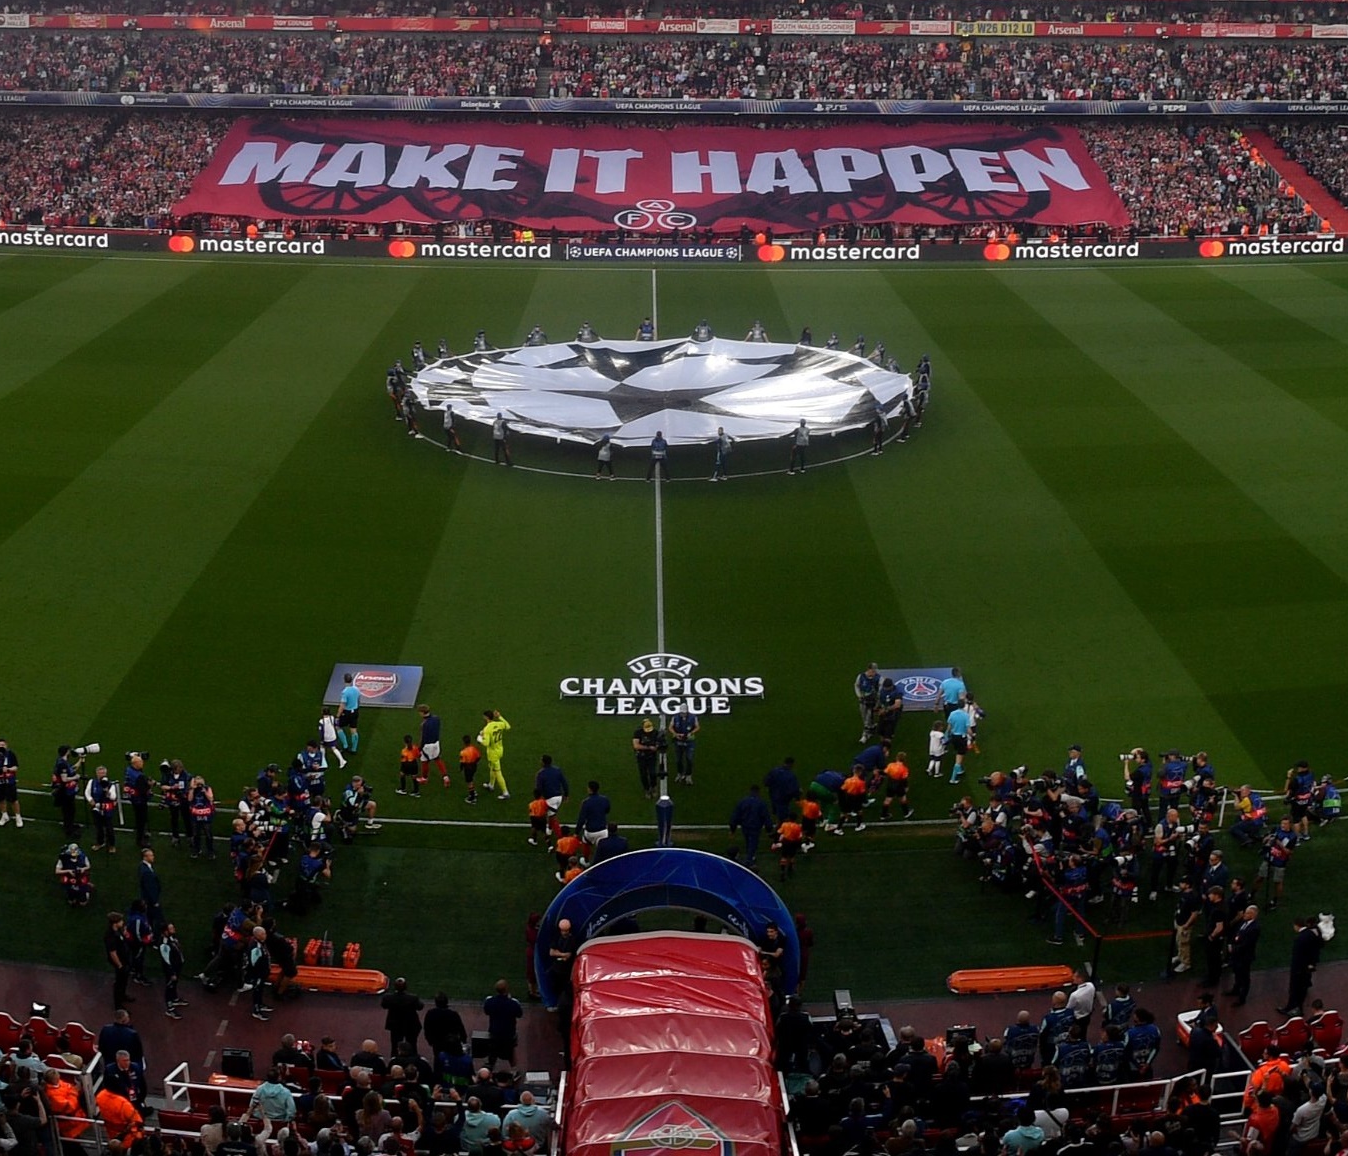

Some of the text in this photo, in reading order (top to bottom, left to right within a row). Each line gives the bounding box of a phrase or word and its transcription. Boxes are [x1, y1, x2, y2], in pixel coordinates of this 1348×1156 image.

[210, 18, 245, 28] Arsenal
[658, 21, 696, 32] Arsenal
[773, 22, 854, 30] SOUTH WALES GOONERS
[977, 24, 997, 34] W26
[1001, 24, 1019, 34] D12
[1048, 25, 1083, 36] Arsenal
[981, 104, 1019, 112] CHAMPIONS
[1163, 104, 1187, 112] PEPSI
[1304, 104, 1338, 112] CHAMPIONS
[218, 142, 1091, 194] MAKE IT HAPPEN
[199, 236, 325, 255] mastercard
[421, 242, 551, 259] mastercard
[791, 244, 921, 261] mastercard
[1015, 240, 1139, 258] mastercard
[1229, 238, 1344, 255] mastercard
[583, 248, 723, 258] UEFA CHAMPIONS LEAGUE
[629, 656, 694, 676] UEFA
[559, 677, 765, 695] CHAMPIONS
[596, 696, 731, 715] LEAGUE
